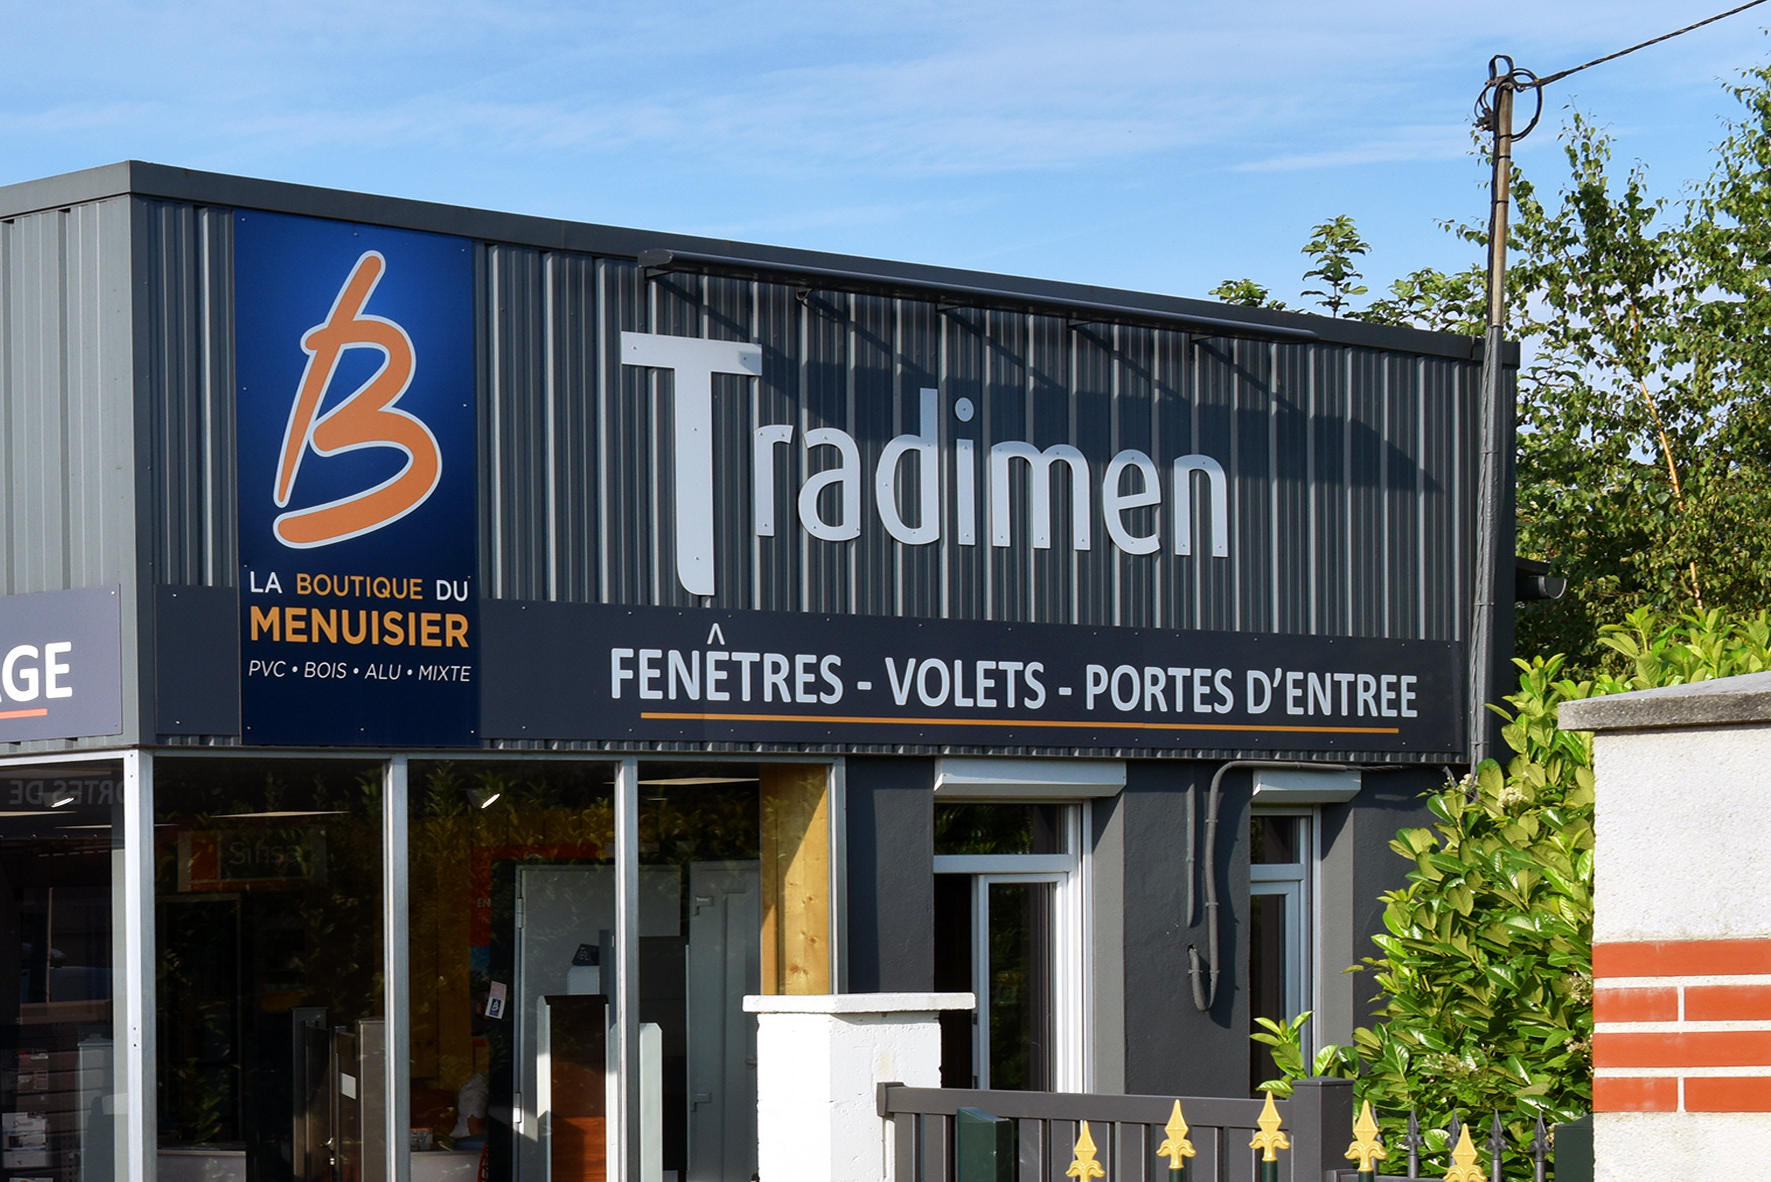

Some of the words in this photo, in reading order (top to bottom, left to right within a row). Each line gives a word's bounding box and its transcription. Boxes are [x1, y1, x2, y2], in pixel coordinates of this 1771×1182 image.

[621, 331, 1228, 596] Tradimen
[250, 570, 283, 594] LA
[296, 573, 424, 600] BOUTIQUE
[436, 579, 469, 602] DU
[250, 605, 469, 648] MENUISIER
[248, 660, 287, 678] PVC
[303, 661, 348, 679] BOIS
[364, 663, 402, 680] ALU
[418, 665, 472, 682] MIXTE
[610, 622, 843, 705] FENÊTRES
[885, 656, 1047, 710] VOLETS
[1086, 663, 1234, 715] PORTES
[1246, 668, 1418, 718] D'ENTREE
